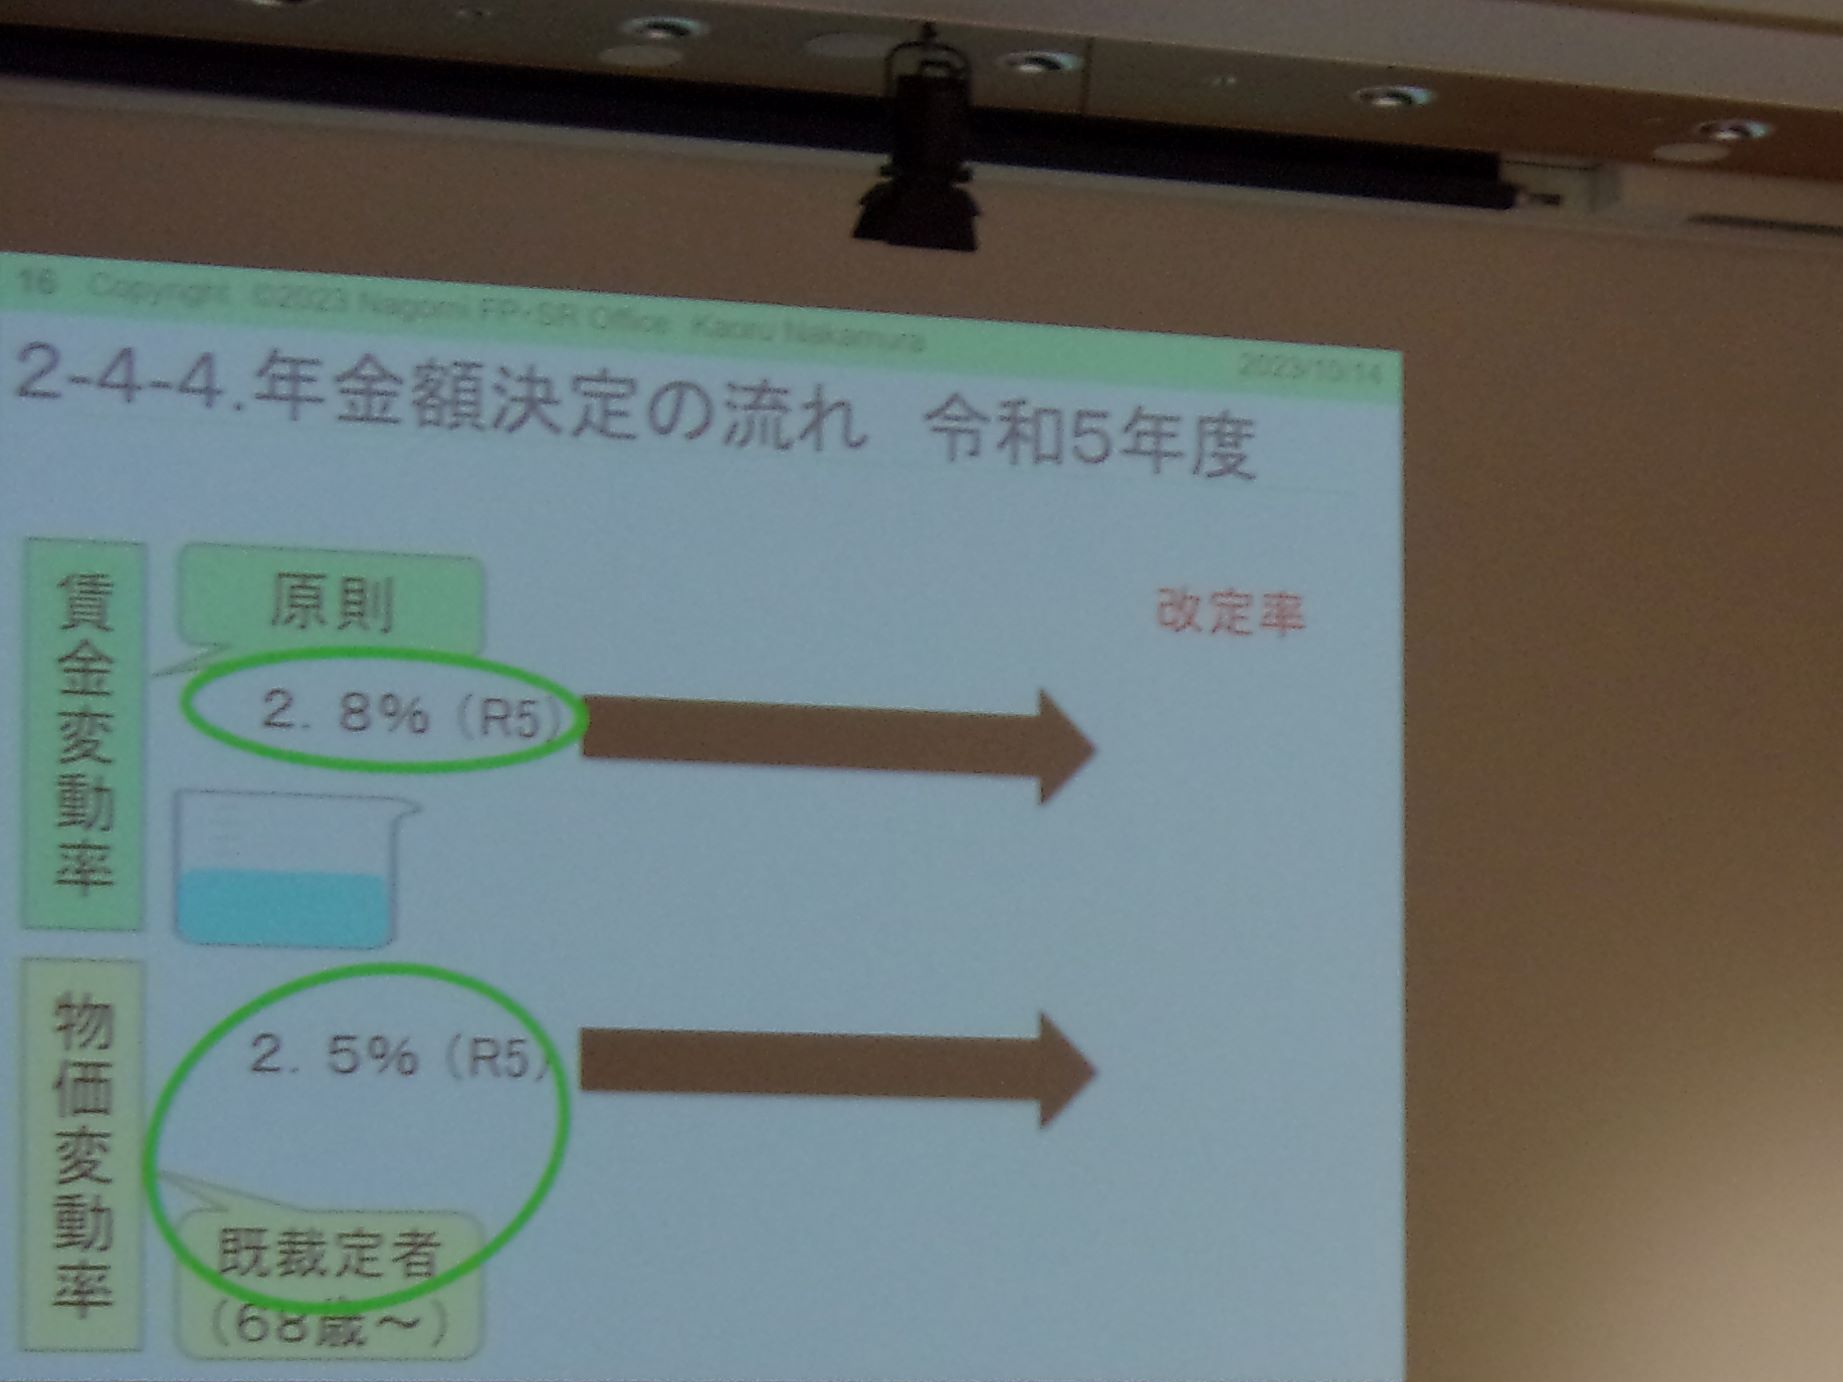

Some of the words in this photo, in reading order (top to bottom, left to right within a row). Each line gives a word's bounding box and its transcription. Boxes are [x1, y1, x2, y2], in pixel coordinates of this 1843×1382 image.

[19, 267, 59, 296] 16
[924, 392, 1258, 481] 令和5年度
[270, 570, 394, 634] 原則
[1155, 587, 1306, 638] 改定率
[56, 572, 115, 896] 賃金変動率
[53, 991, 114, 1318] 物価変動率
[219, 1227, 442, 1280] 既裁定者
